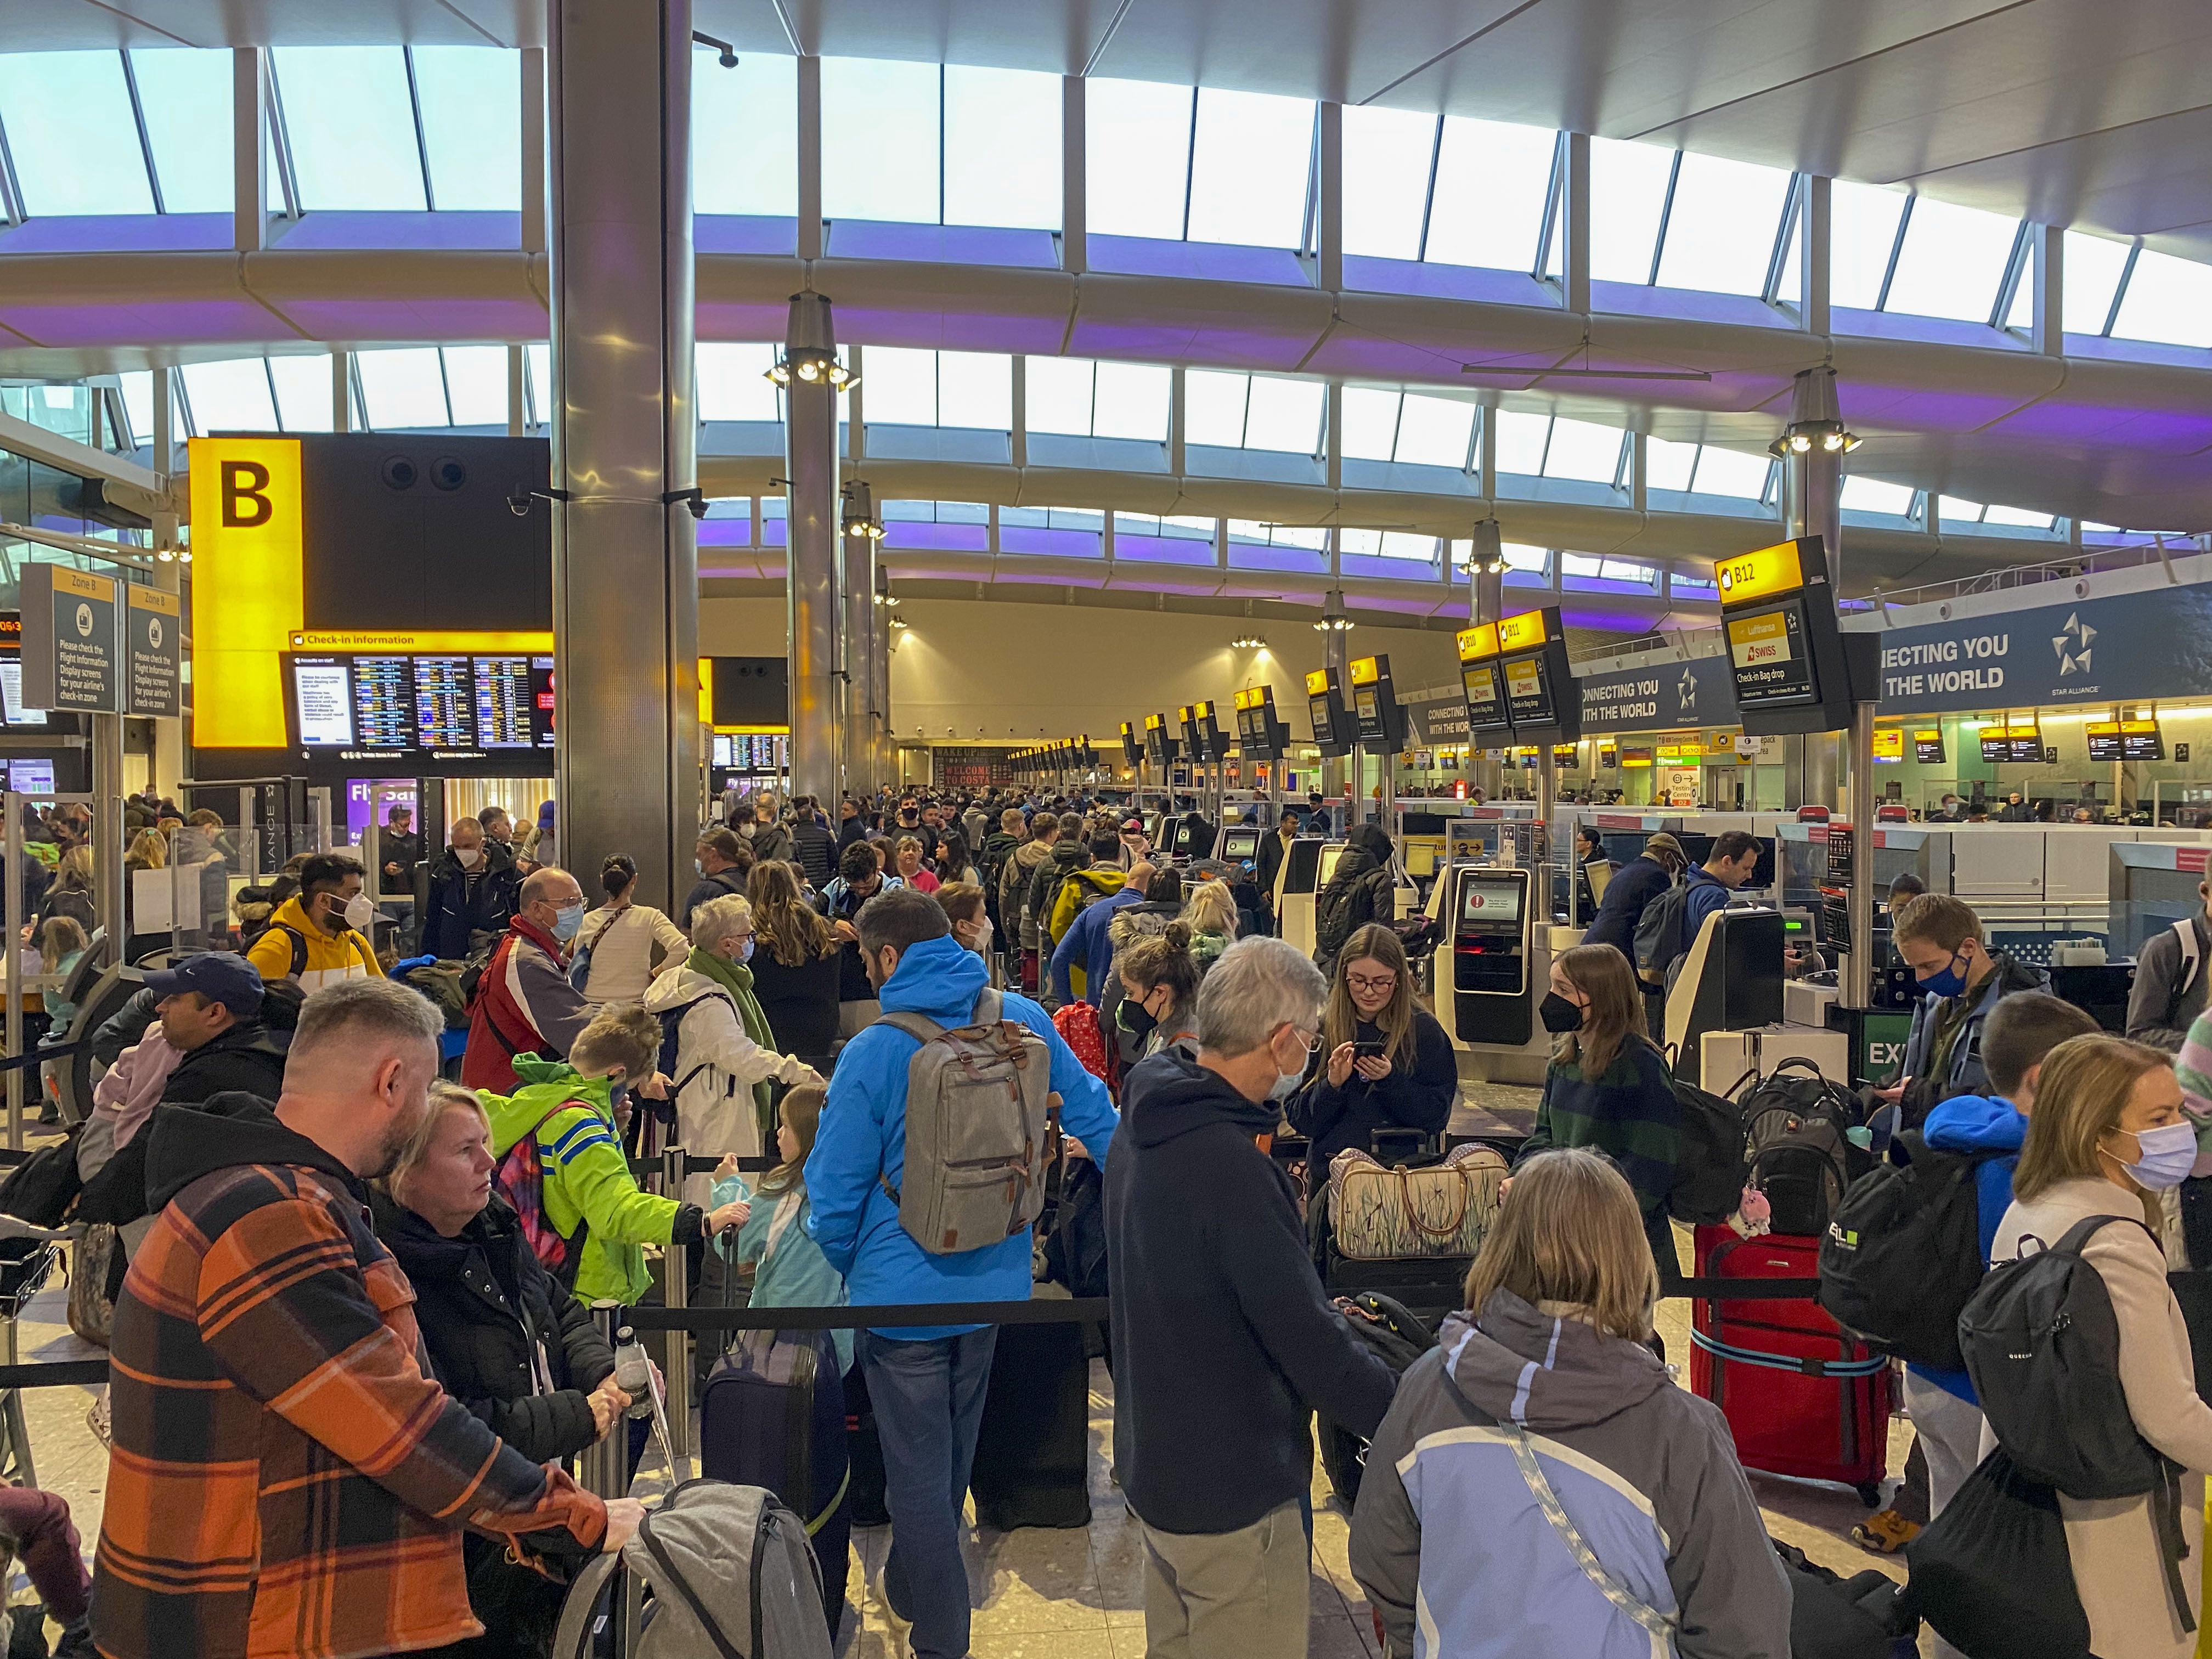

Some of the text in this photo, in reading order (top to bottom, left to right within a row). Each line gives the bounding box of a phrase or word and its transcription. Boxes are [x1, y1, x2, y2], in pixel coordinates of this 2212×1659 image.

[221, 460, 272, 527] B
[1735, 563, 1754, 583] B12
[72, 575, 96, 590] Zone B
[145, 592, 165, 606] Zone B
[1508, 623, 1520, 636] B11
[1747, 623, 1775, 635] Lufthansa
[307, 635, 351, 644] Check-in
[1466, 634, 1476, 647] B10
[60, 639, 103, 655] Please check the
[1756, 646, 1776, 657] SWISS
[1882, 634, 2008, 668] ECTING YOU
[60, 653, 108, 668] Flight Information
[135, 652, 149, 662] Please
[150, 653, 162, 664] check
[60, 665, 101, 678] Display screens
[135, 663, 174, 676] Flight Information
[1737, 669, 1785, 682] Check-in Bag drop
[60, 676, 104, 691] for your airline's
[135, 675, 169, 687] Display screens
[1521, 682, 1533, 691] SWISS
[1886, 667, 2005, 697] THE WORLD
[60, 689, 97, 703] check-in zone
[143, 689, 154, 697] your
[154, 688, 171, 698] airline's
[1583, 679, 1659, 702] ONNECTING YOU
[2068, 686, 2099, 695] ALLIANCE
[135, 697, 153, 707] check-in
[1428, 706, 1464, 720] CONNECTING
[1583, 702, 1656, 723] ITH THE WORLD
[1429, 721, 1469, 735] WITH THE WOR
[1760, 735, 1776, 745] epack
[946, 766, 991, 775] WELCOME
[946, 776, 957, 784] TO
[960, 775, 990, 784] COSTA
[267, 805, 275, 873] LIANCE
[1870, 1043, 1906, 1063] EX
